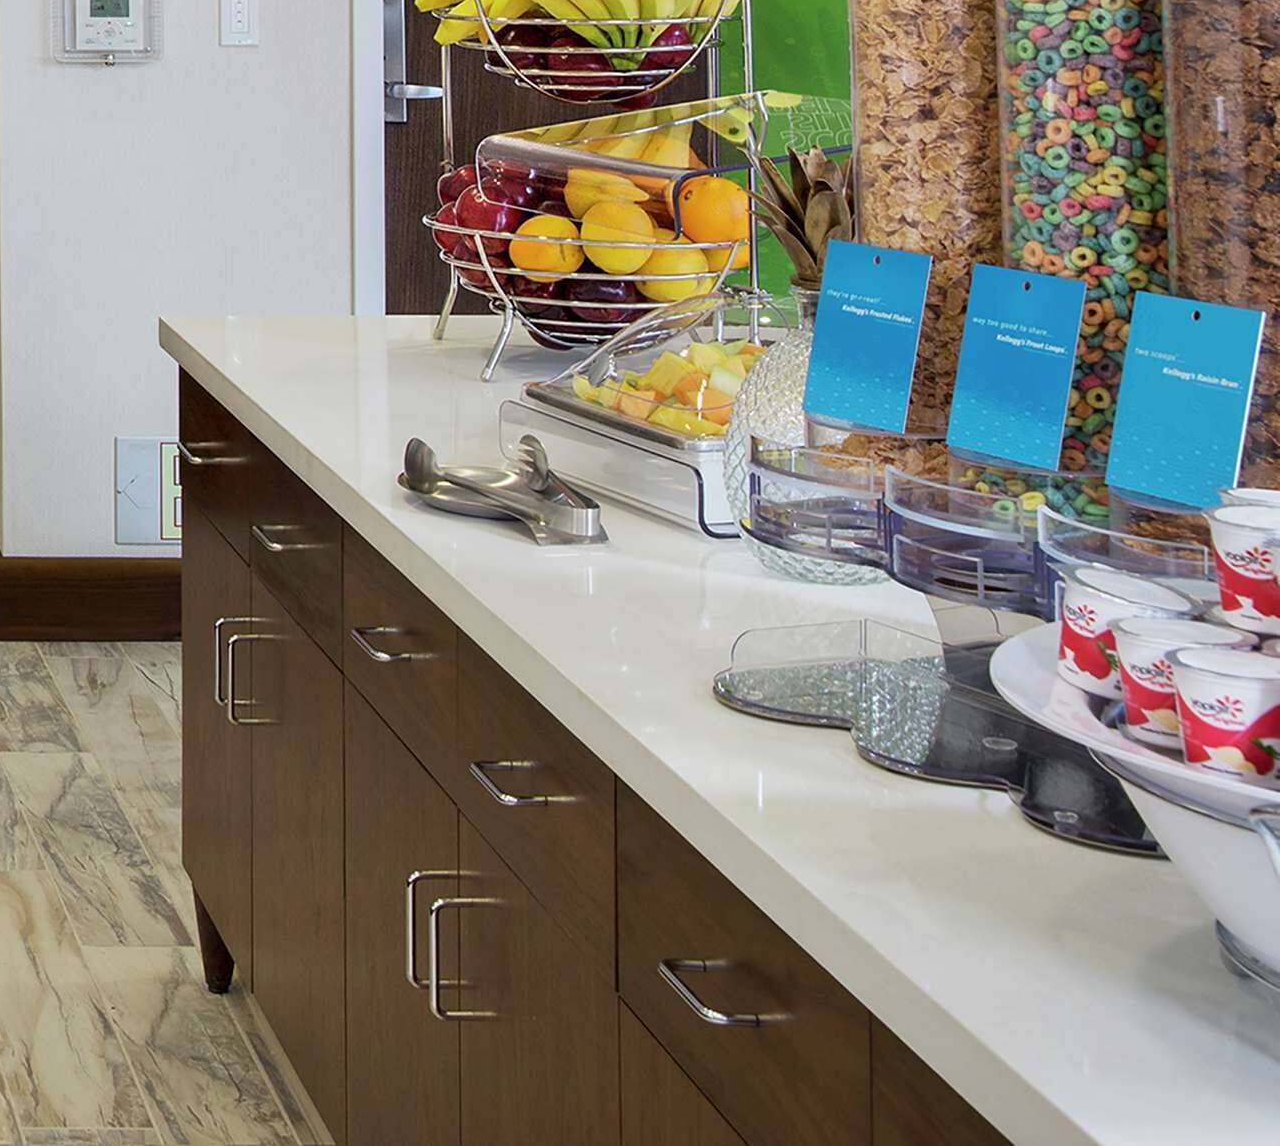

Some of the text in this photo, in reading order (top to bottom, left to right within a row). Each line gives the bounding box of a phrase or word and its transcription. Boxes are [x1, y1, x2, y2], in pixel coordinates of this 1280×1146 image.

[842, 304, 869, 316] Kellogg's
[1000, 322, 1018, 331] good
[996, 334, 1026, 347] Kellogg's
[1162, 367, 1196, 381] Kellogg's
